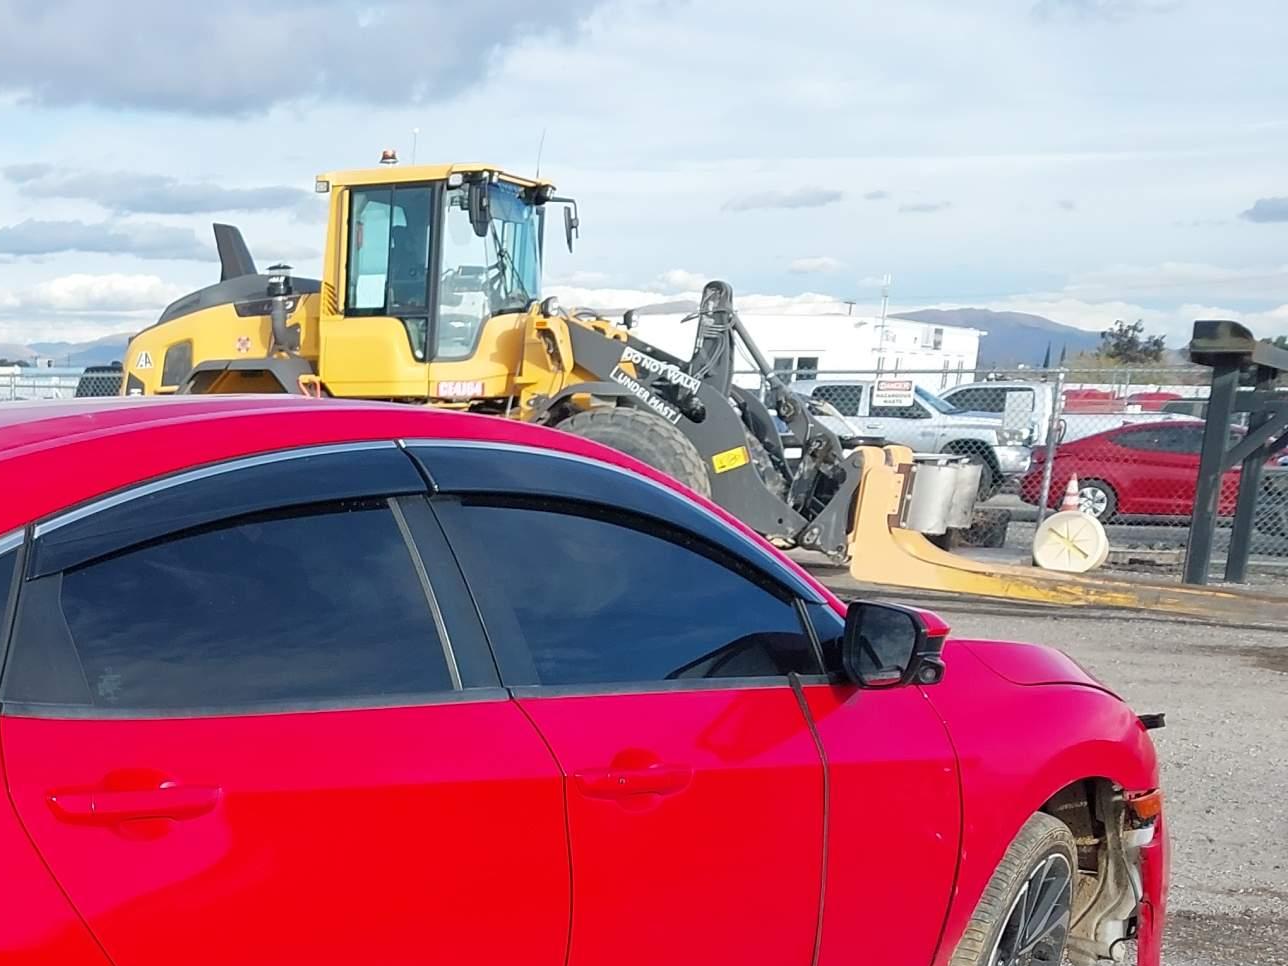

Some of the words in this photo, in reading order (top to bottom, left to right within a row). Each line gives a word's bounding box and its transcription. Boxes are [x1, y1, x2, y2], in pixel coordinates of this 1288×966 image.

[624, 351, 642, 365] DO
[642, 357, 667, 376] NOT
[667, 370, 697, 390] WALK
[618, 373, 649, 406] UNDER
[648, 396, 676, 422] MAST
